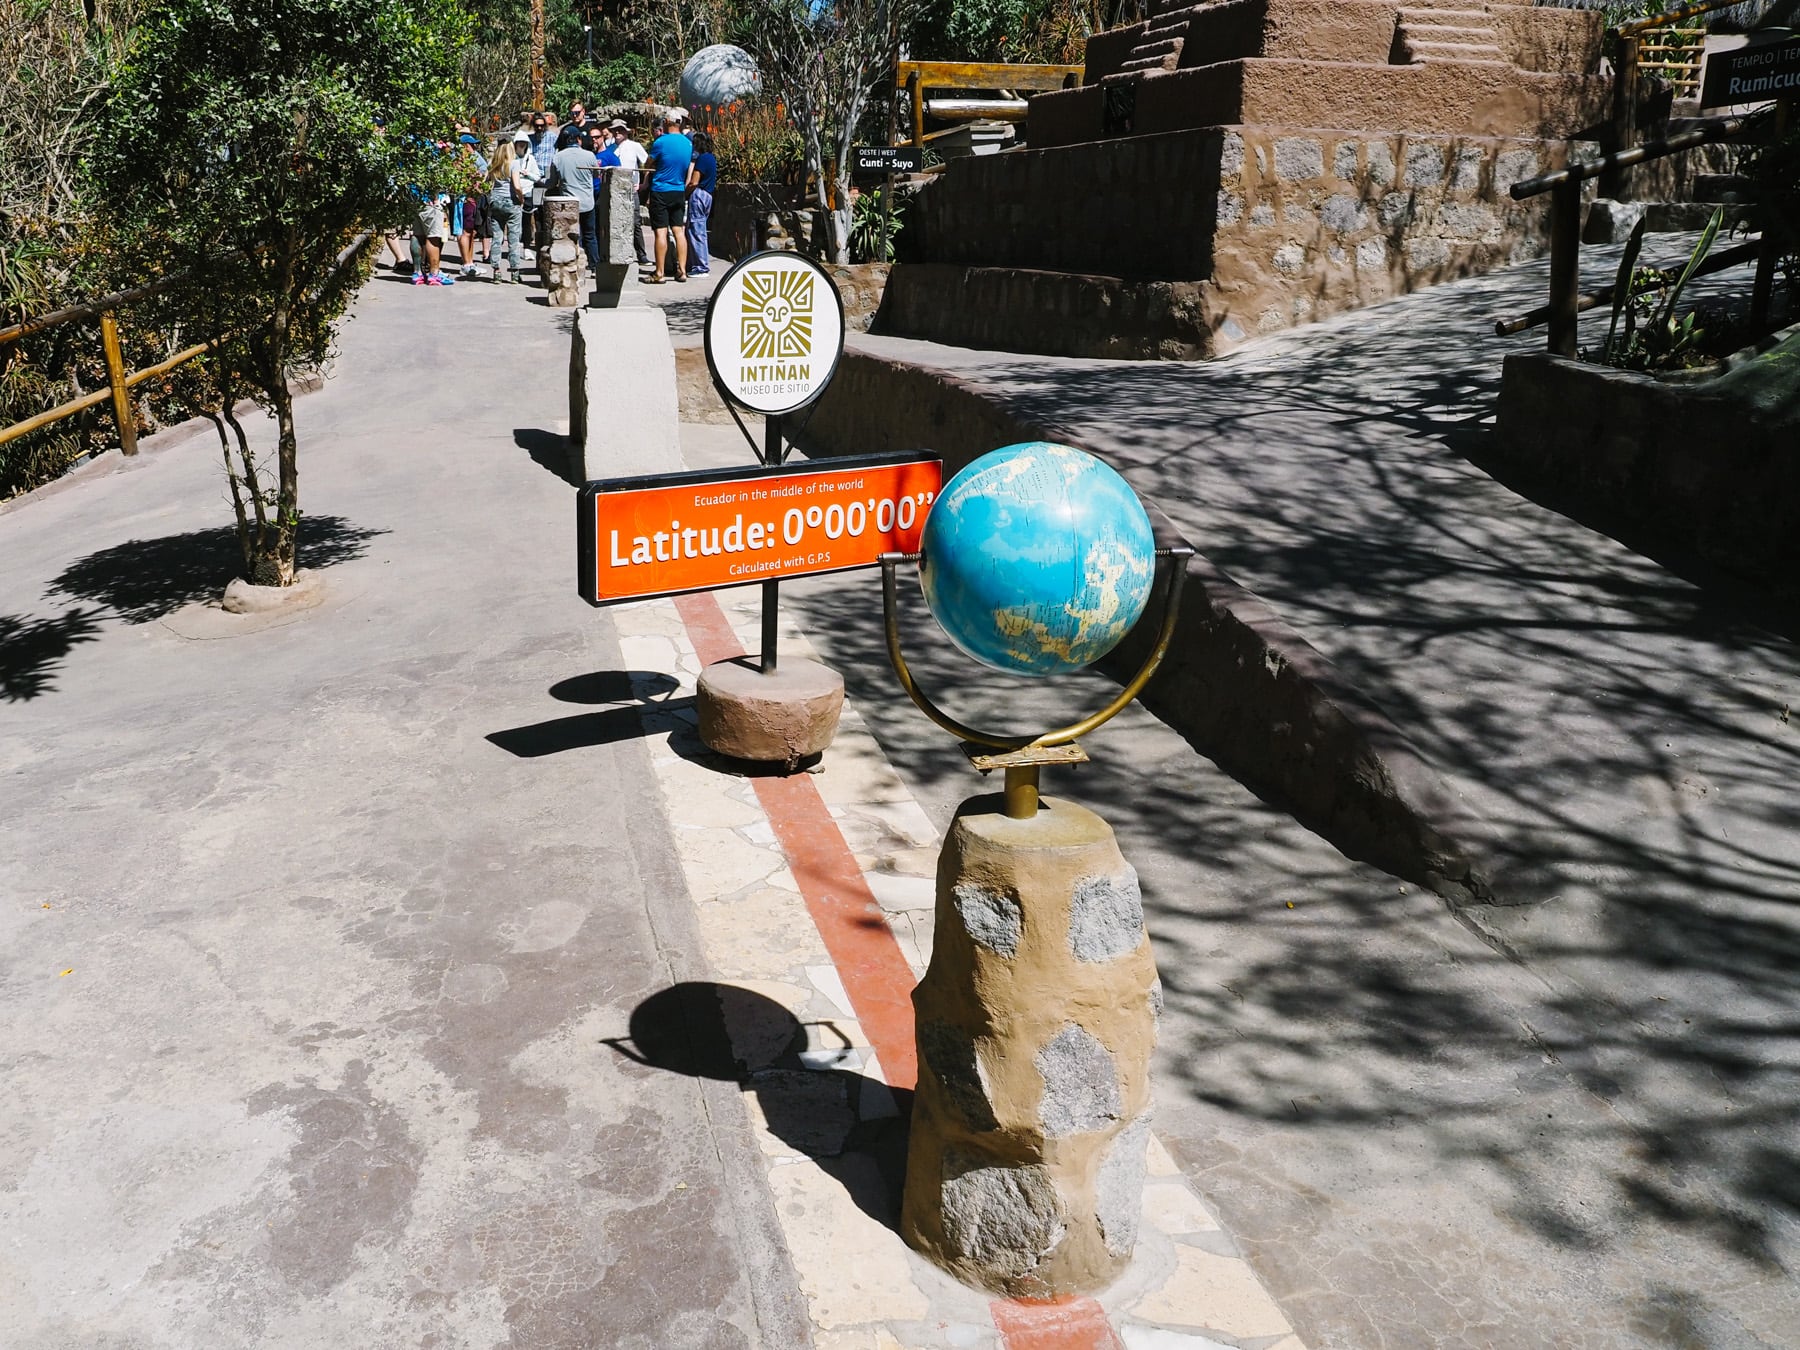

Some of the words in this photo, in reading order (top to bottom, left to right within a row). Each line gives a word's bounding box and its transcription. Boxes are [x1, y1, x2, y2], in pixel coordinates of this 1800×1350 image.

[1732, 52, 1774, 68] TEMPLO
[860, 158, 883, 167] Cunti
[892, 159, 913, 170] Suyo
[740, 360, 810, 382] INTIÑAN
[740, 385, 770, 395] MUSEO
[773, 384, 785, 394] DE
[787, 383, 810, 393] SITIO
[694, 492, 736, 507] Ecuador
[739, 491, 748, 501] in
[752, 489, 767, 500] the
[771, 483, 802, 498] middle
[806, 482, 817, 494] of
[819, 481, 835, 492] the
[837, 478, 864, 490] world
[610, 514, 775, 567] Latitude:
[729, 558, 781, 575] Calculated
[784, 555, 804, 568] with
[807, 552, 831, 565] G.P.S
